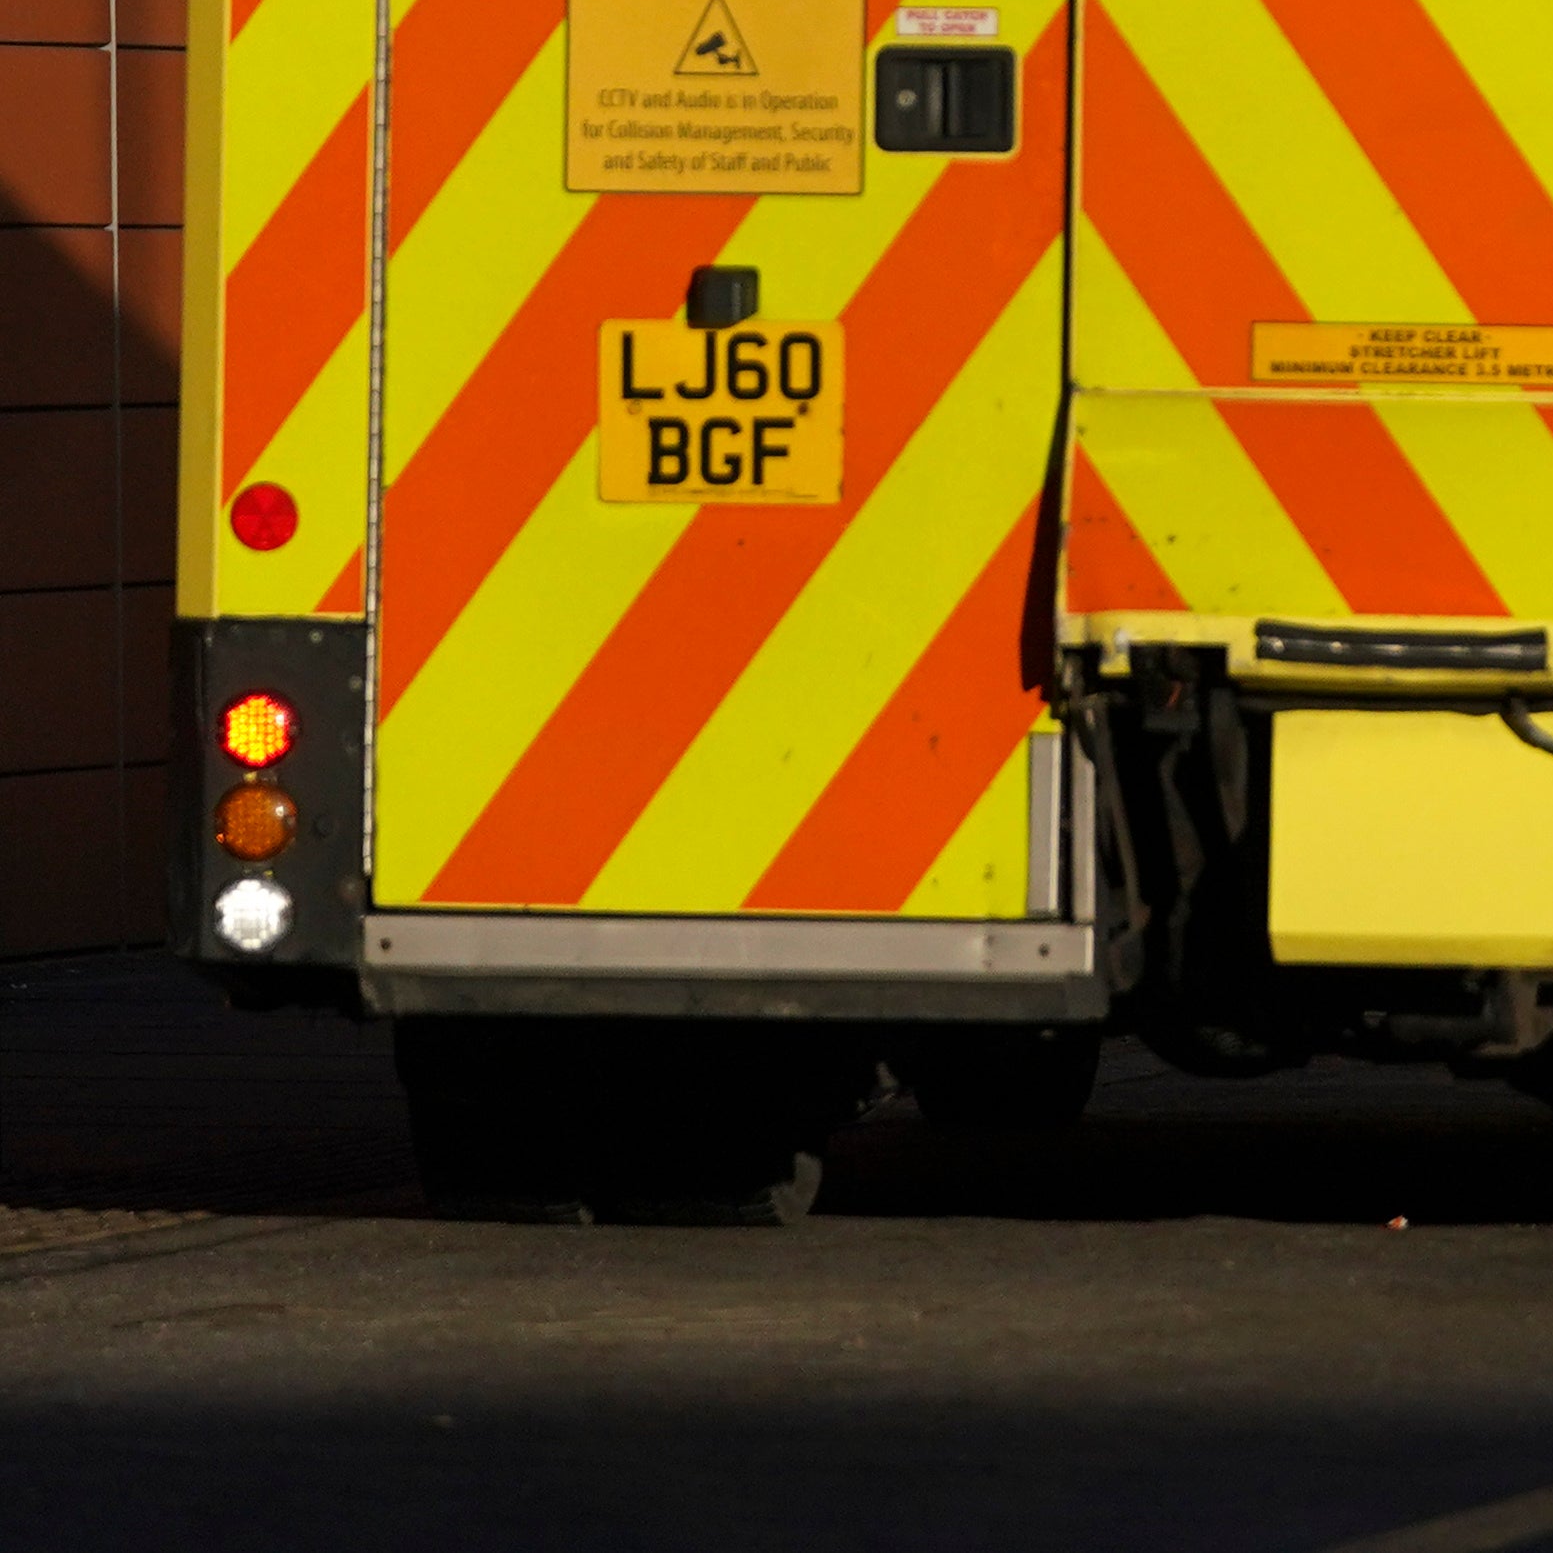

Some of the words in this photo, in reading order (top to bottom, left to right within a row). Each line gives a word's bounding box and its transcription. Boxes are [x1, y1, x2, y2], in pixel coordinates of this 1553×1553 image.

[598, 88, 638, 108] CCTV
[643, 90, 673, 108] and
[677, 89, 720, 109] Audio
[761, 90, 839, 112] Operation
[582, 119, 604, 139] for
[607, 120, 673, 139] Collision
[791, 121, 856, 146] Security
[603, 151, 634, 170] and
[637, 151, 687, 174] Safety
[690, 151, 710, 171] of
[711, 153, 748, 171] Staff
[751, 153, 781, 172] and
[783, 153, 832, 172] Public
[1369, 330, 1417, 343] KEEP
[1424, 330, 1483, 344] CLEAR
[1348, 346, 1458, 359] STRETCHER
[1463, 347, 1501, 360] LIFT
[621, 331, 822, 400] LJ60
[1270, 361, 1354, 375] MINIMUM
[1360, 362, 1467, 376] CLEARANCE
[648, 417, 796, 485] BGF
